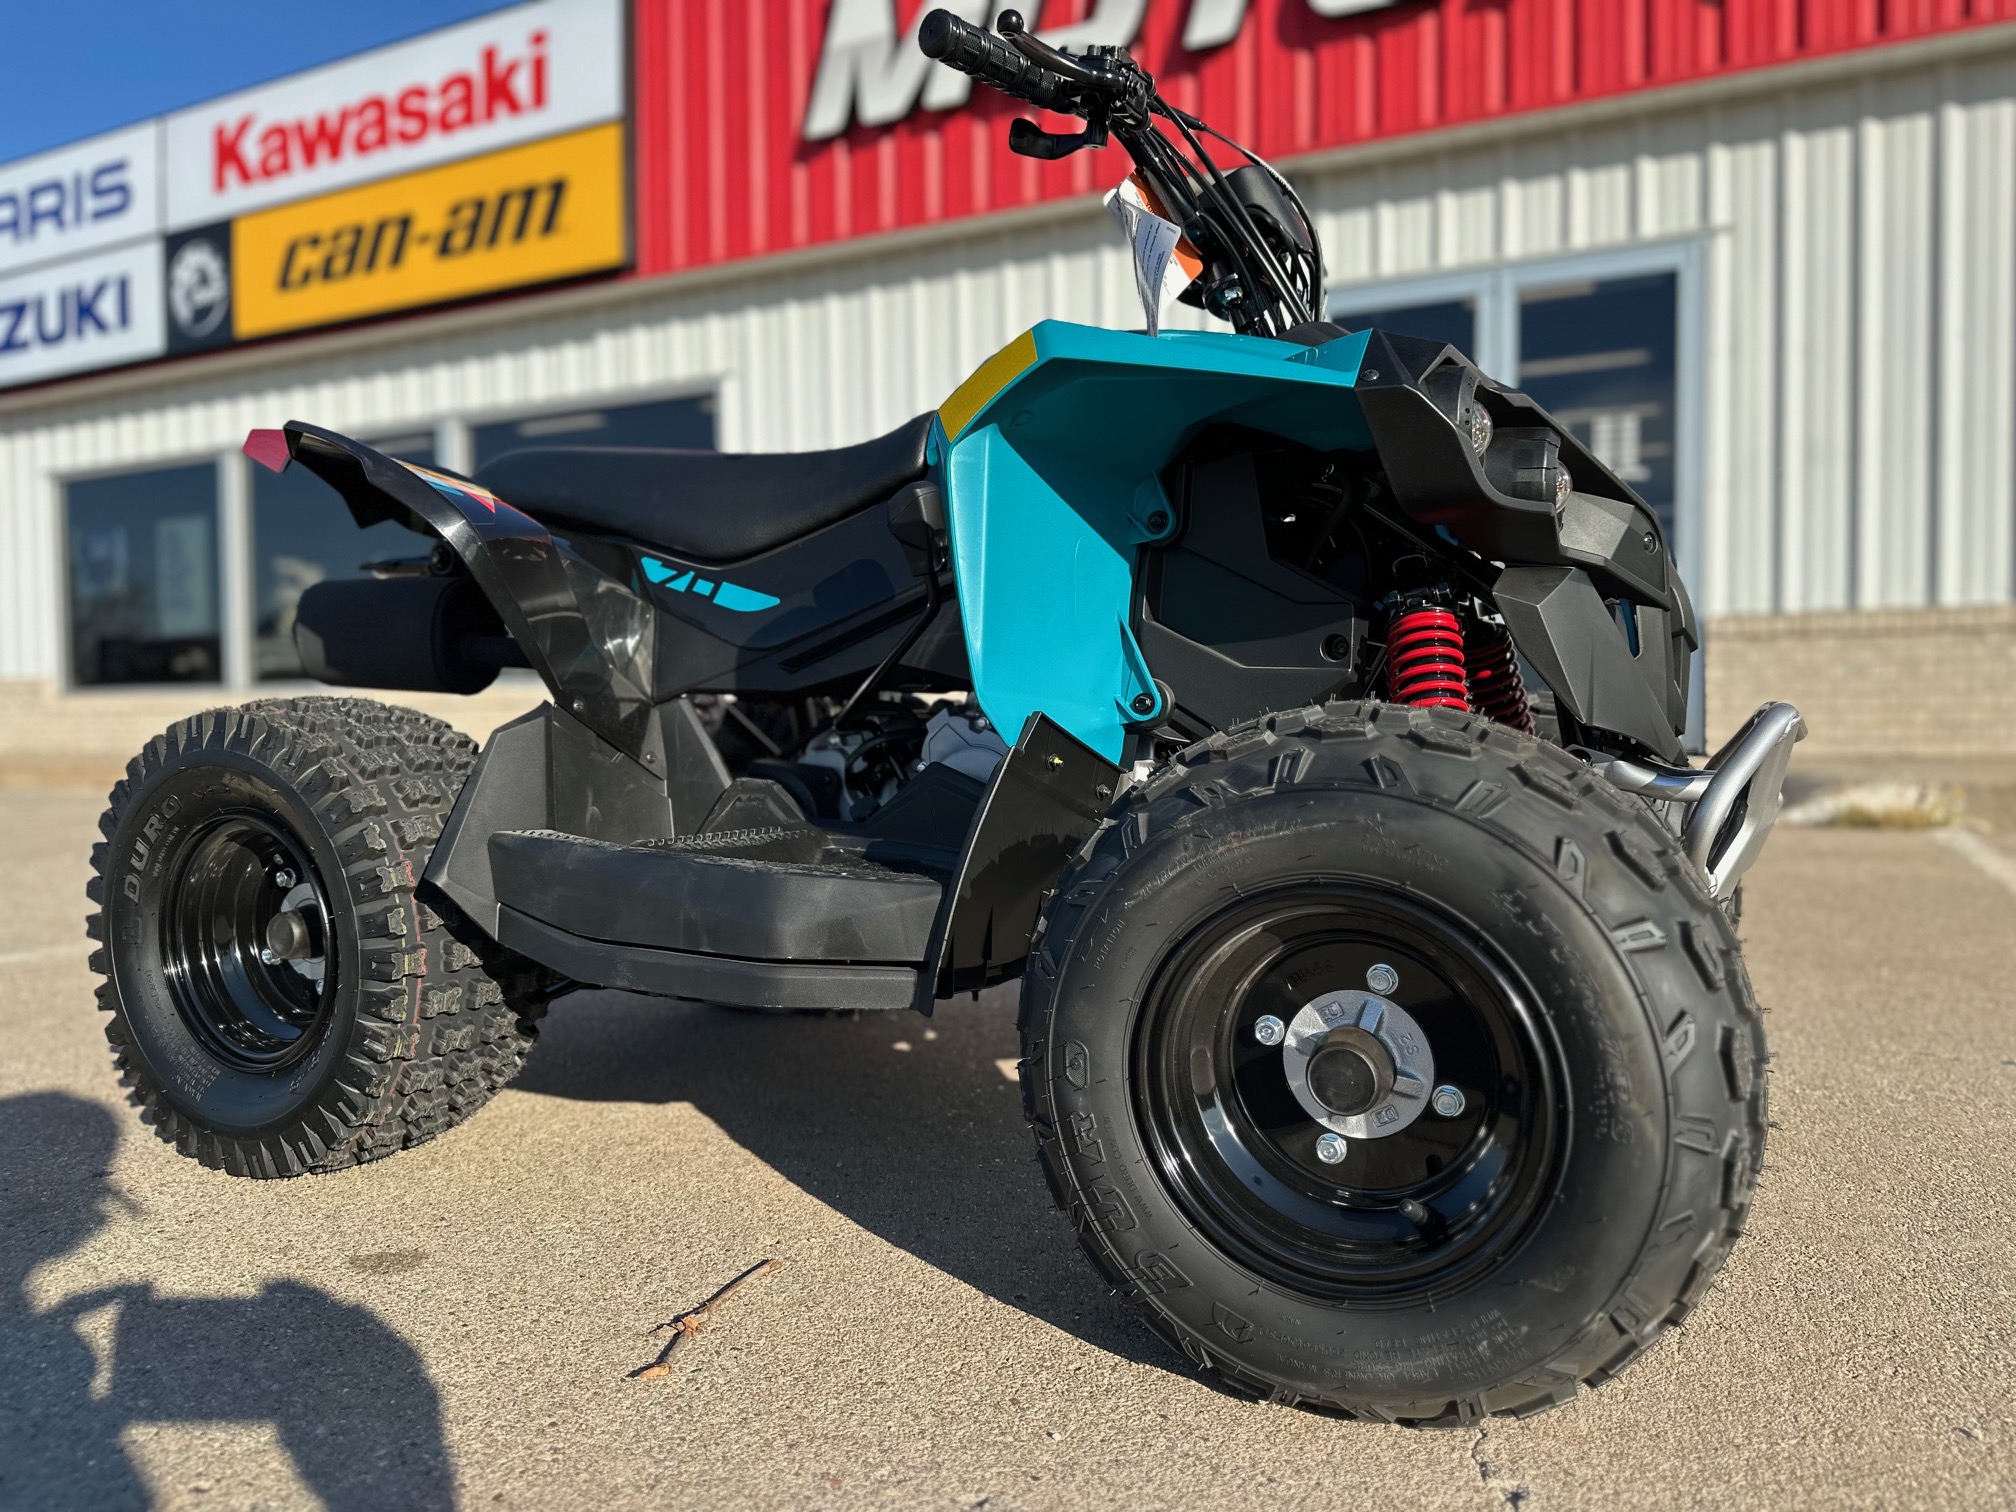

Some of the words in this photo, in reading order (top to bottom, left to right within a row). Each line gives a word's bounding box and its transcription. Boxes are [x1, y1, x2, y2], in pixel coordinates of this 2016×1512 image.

[213, 30, 549, 194] Kawasaki
[276, 176, 568, 290] can-am
[124, 794, 183, 905] DURO
[1272, 1350, 1317, 1373] MANUAL
[1353, 1349, 1400, 1361] BEYOND
